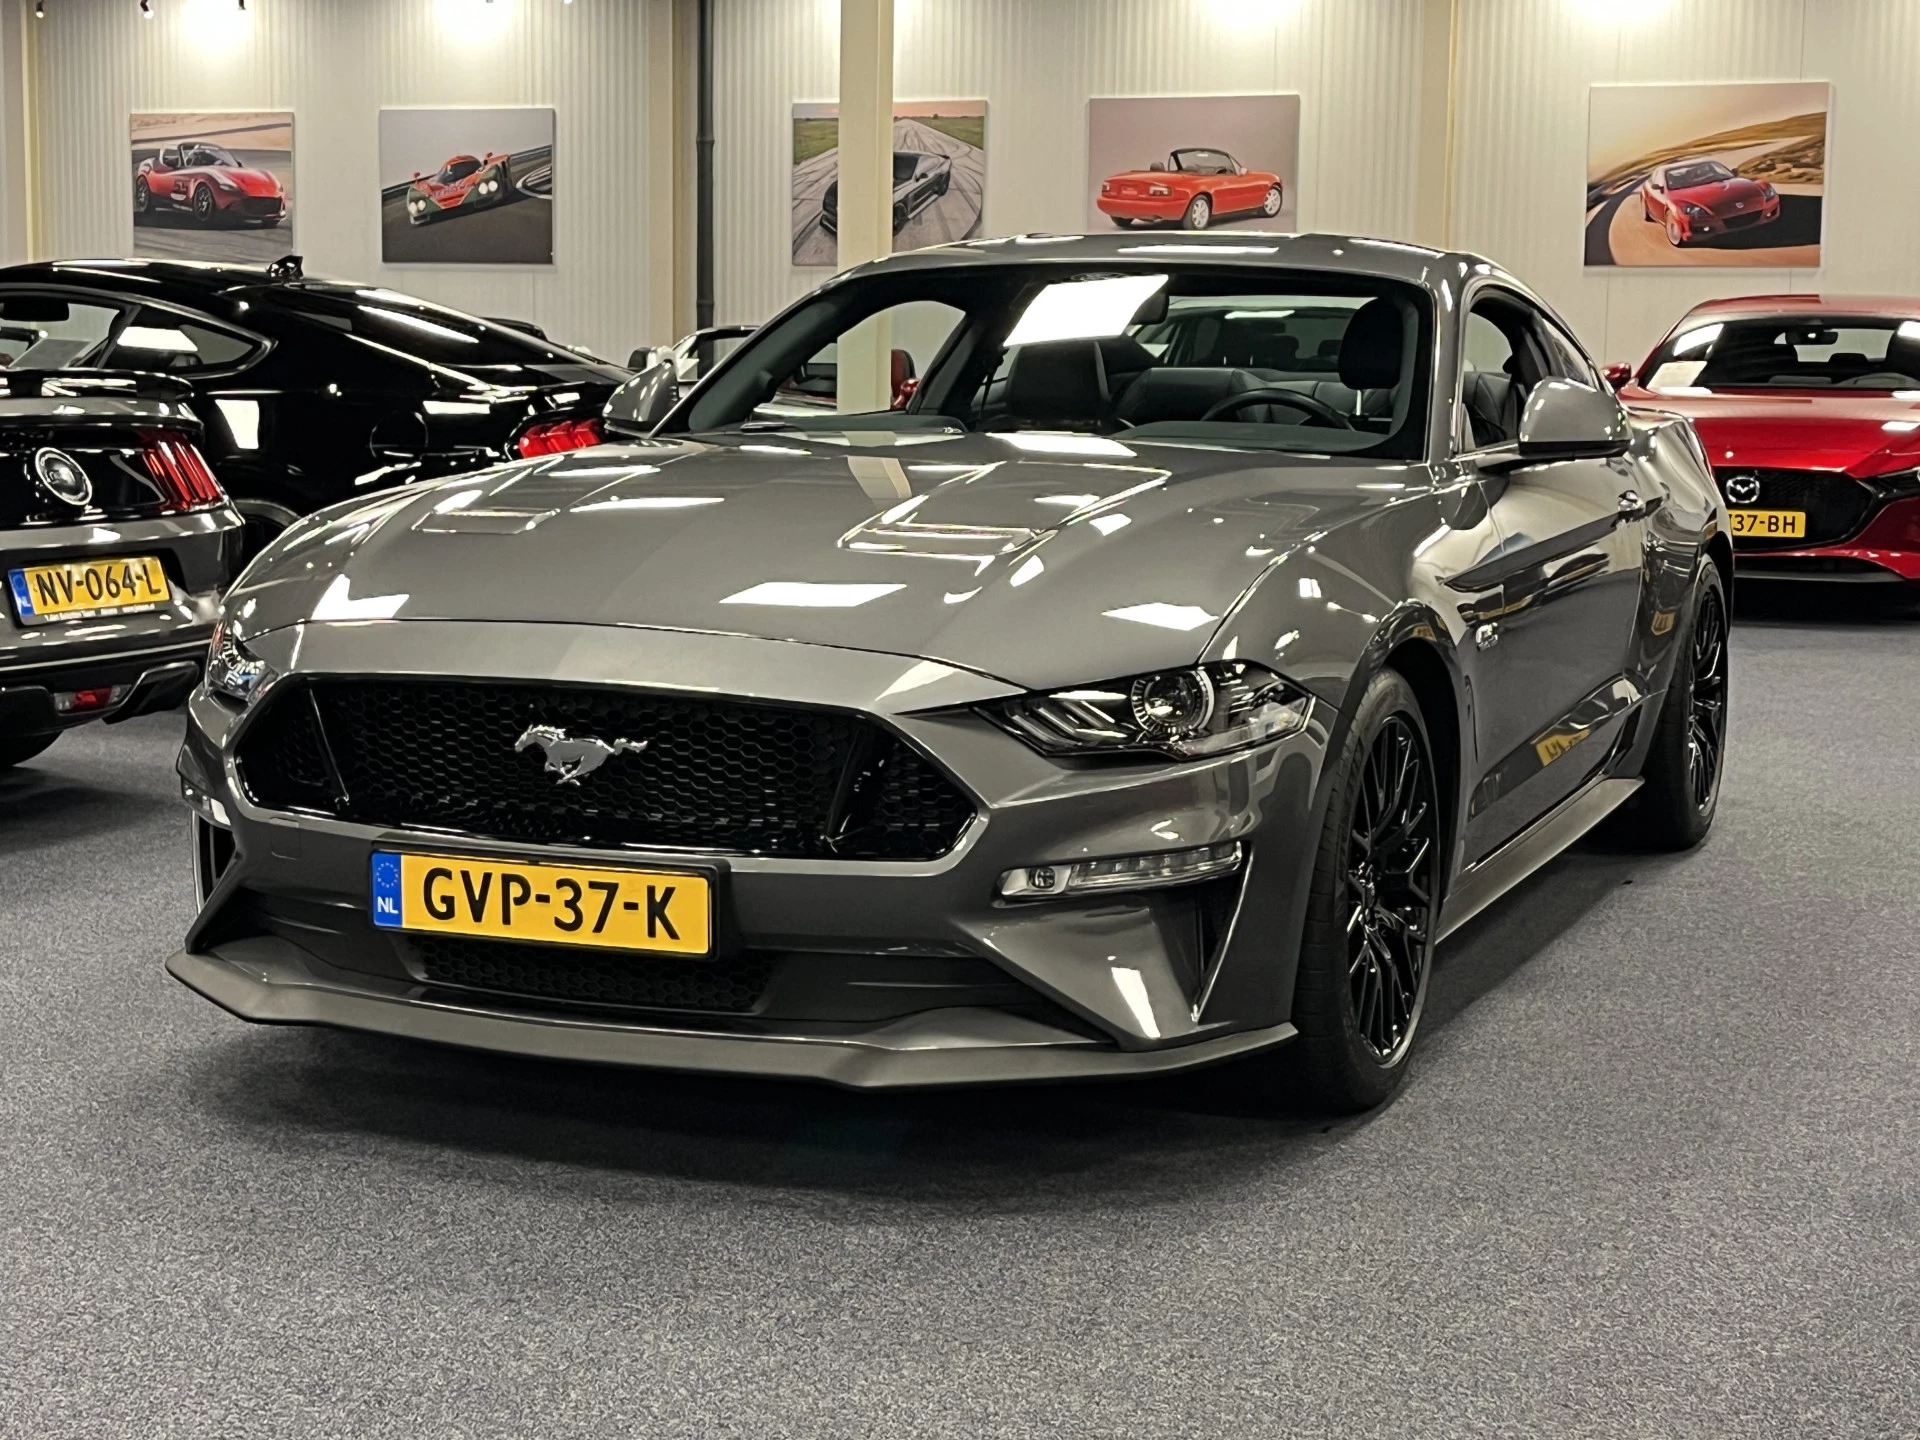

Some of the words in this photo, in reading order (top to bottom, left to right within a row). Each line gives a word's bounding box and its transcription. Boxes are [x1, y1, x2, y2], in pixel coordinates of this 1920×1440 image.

[1729, 514, 1796, 534] 37-BH
[35, 564, 161, 606] NV-064-L
[377, 896, 399, 915] NL
[423, 867, 680, 940] GVP-37-K
